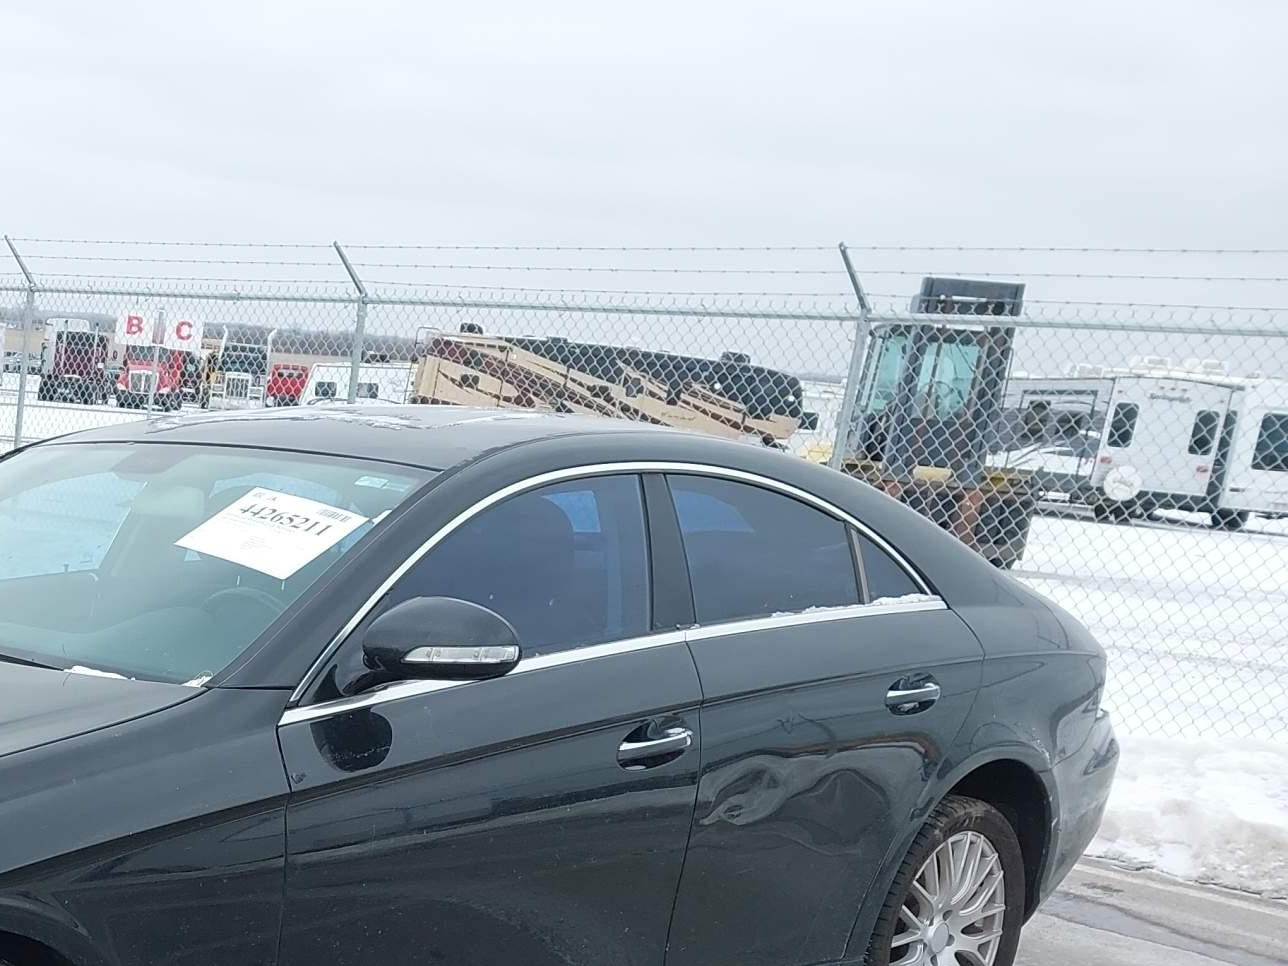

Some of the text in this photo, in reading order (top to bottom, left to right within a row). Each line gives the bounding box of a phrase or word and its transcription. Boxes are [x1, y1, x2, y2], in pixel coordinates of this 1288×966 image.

[126, 315, 144, 335] B
[176, 321, 193, 341] C
[239, 503, 333, 537] 44265211
